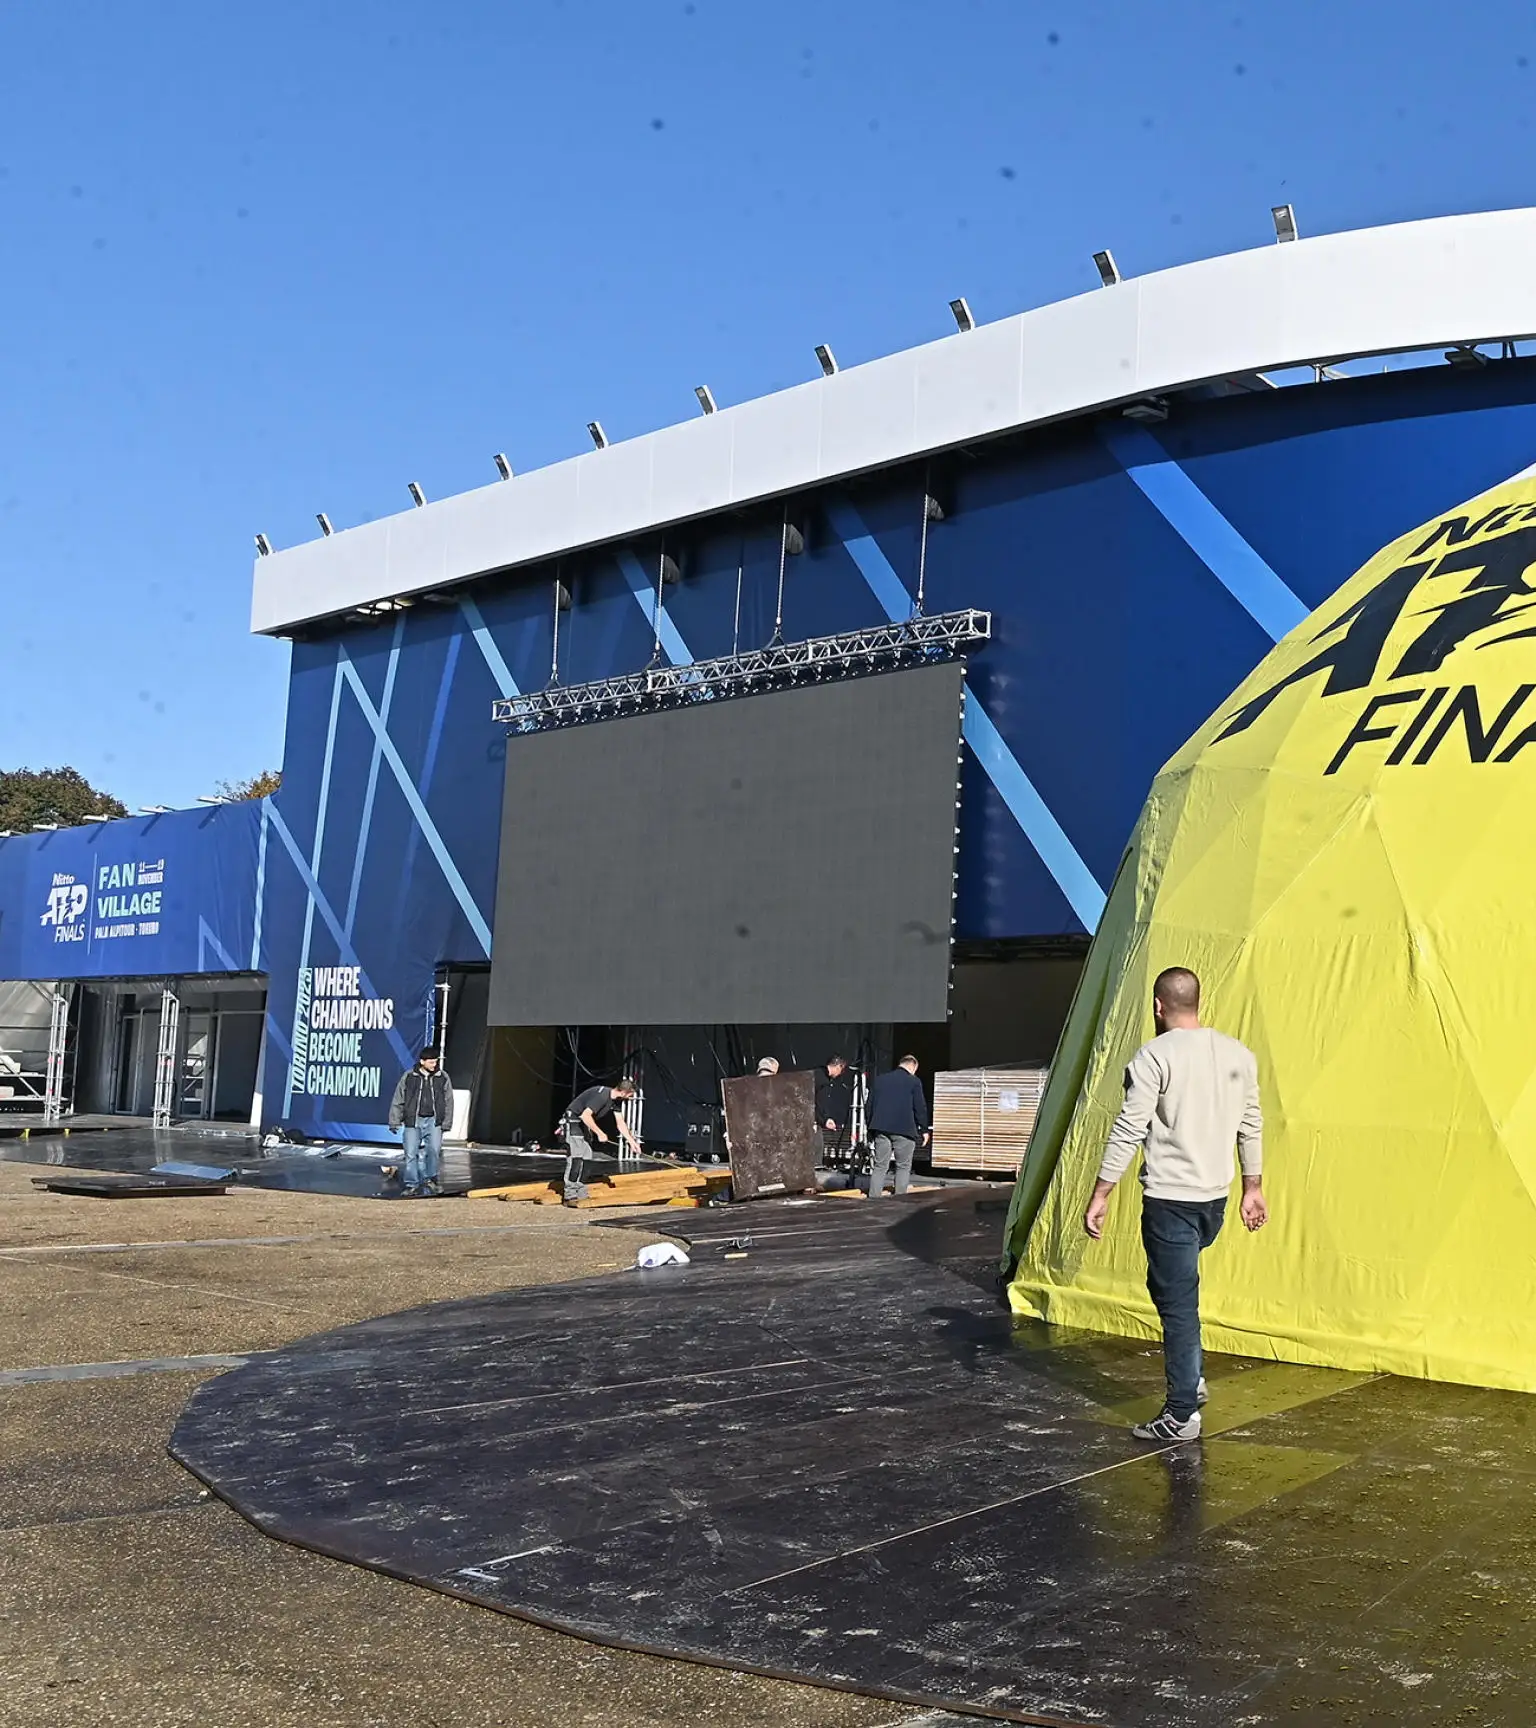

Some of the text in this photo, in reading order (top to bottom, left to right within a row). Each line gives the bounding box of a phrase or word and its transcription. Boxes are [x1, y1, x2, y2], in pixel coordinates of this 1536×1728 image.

[52, 873, 75, 886] Nitto
[99, 863, 136, 890] FAN
[40, 884, 89, 926] ATP
[97, 891, 162, 918] VILLAGE
[54, 923, 85, 943] FINALS
[314, 966, 361, 997] WHERE
[311, 998, 394, 1030] CHAMPIONS
[291, 1020, 308, 1091] TORINO
[309, 1032, 363, 1063] BECOME
[307, 1065, 381, 1098] CHAMPION
